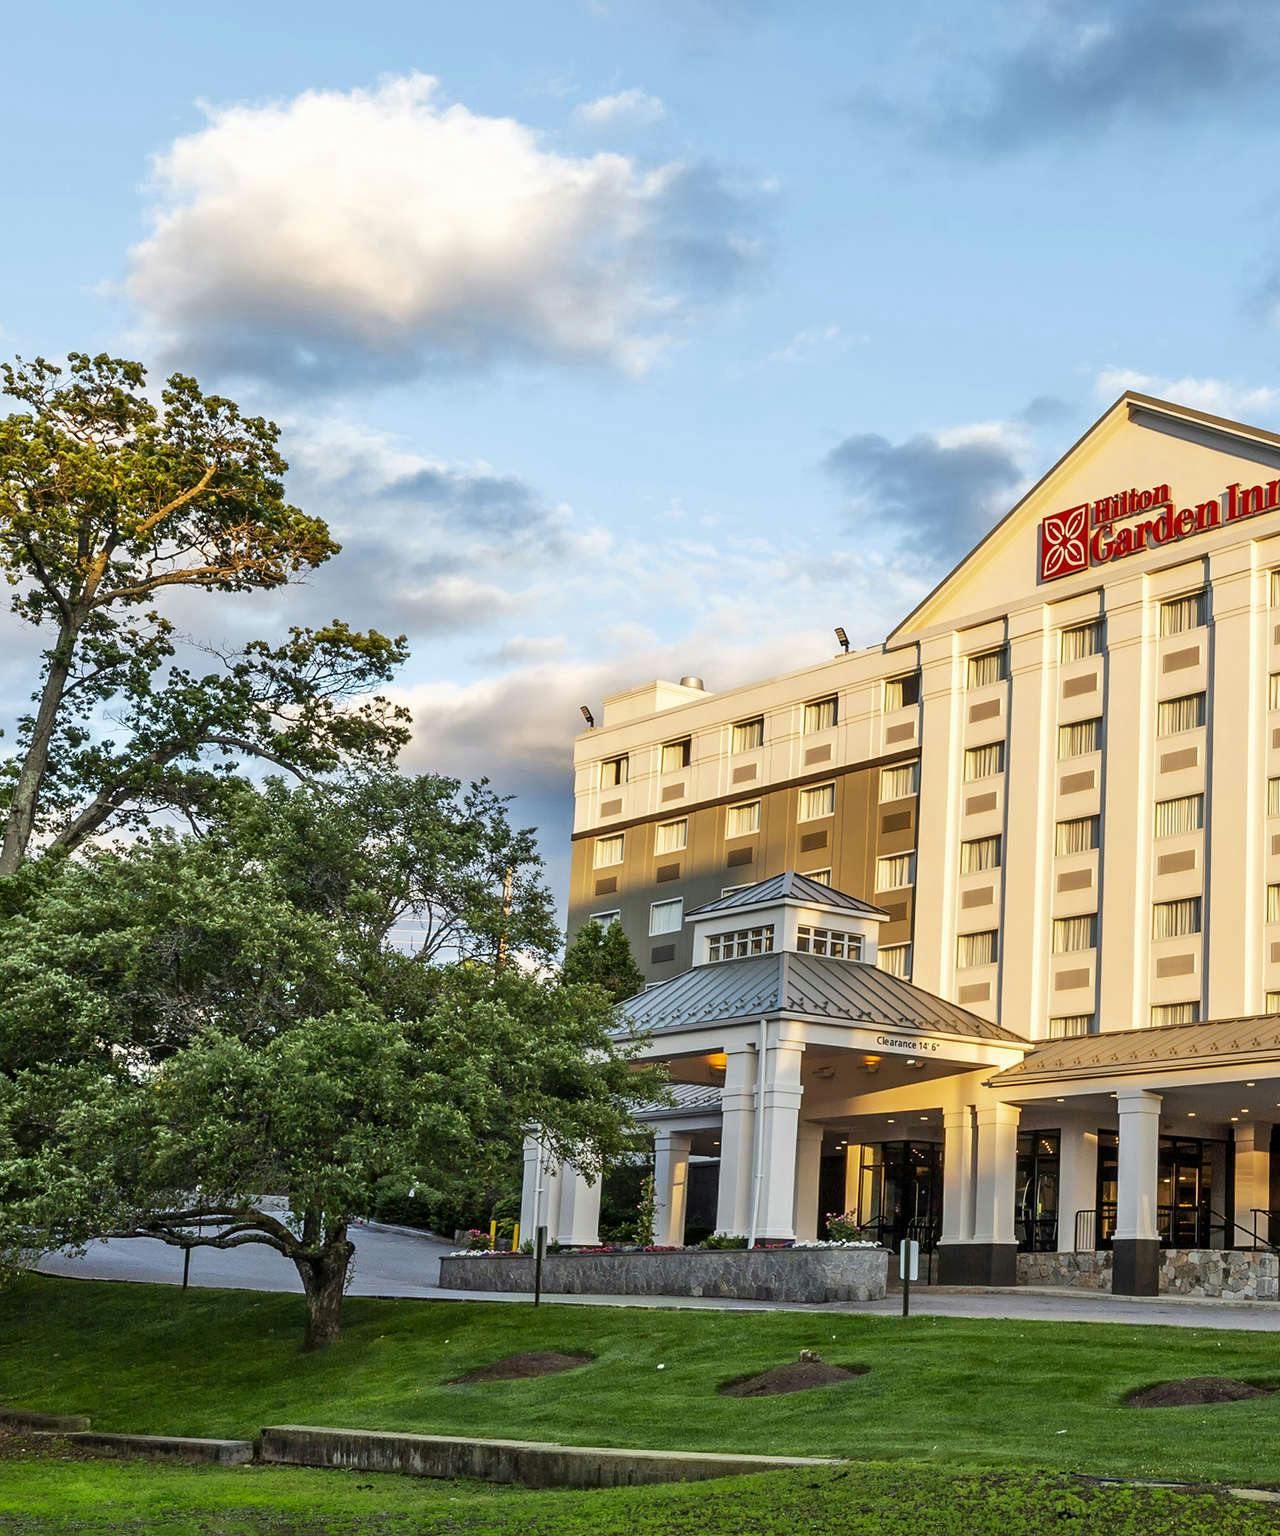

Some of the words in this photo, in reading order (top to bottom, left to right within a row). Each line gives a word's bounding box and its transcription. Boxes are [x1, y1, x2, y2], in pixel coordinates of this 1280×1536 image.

[1093, 483, 1170, 524] Hilton
[1090, 499, 1222, 562] Garden
[876, 1036, 917, 1050] Clearance
